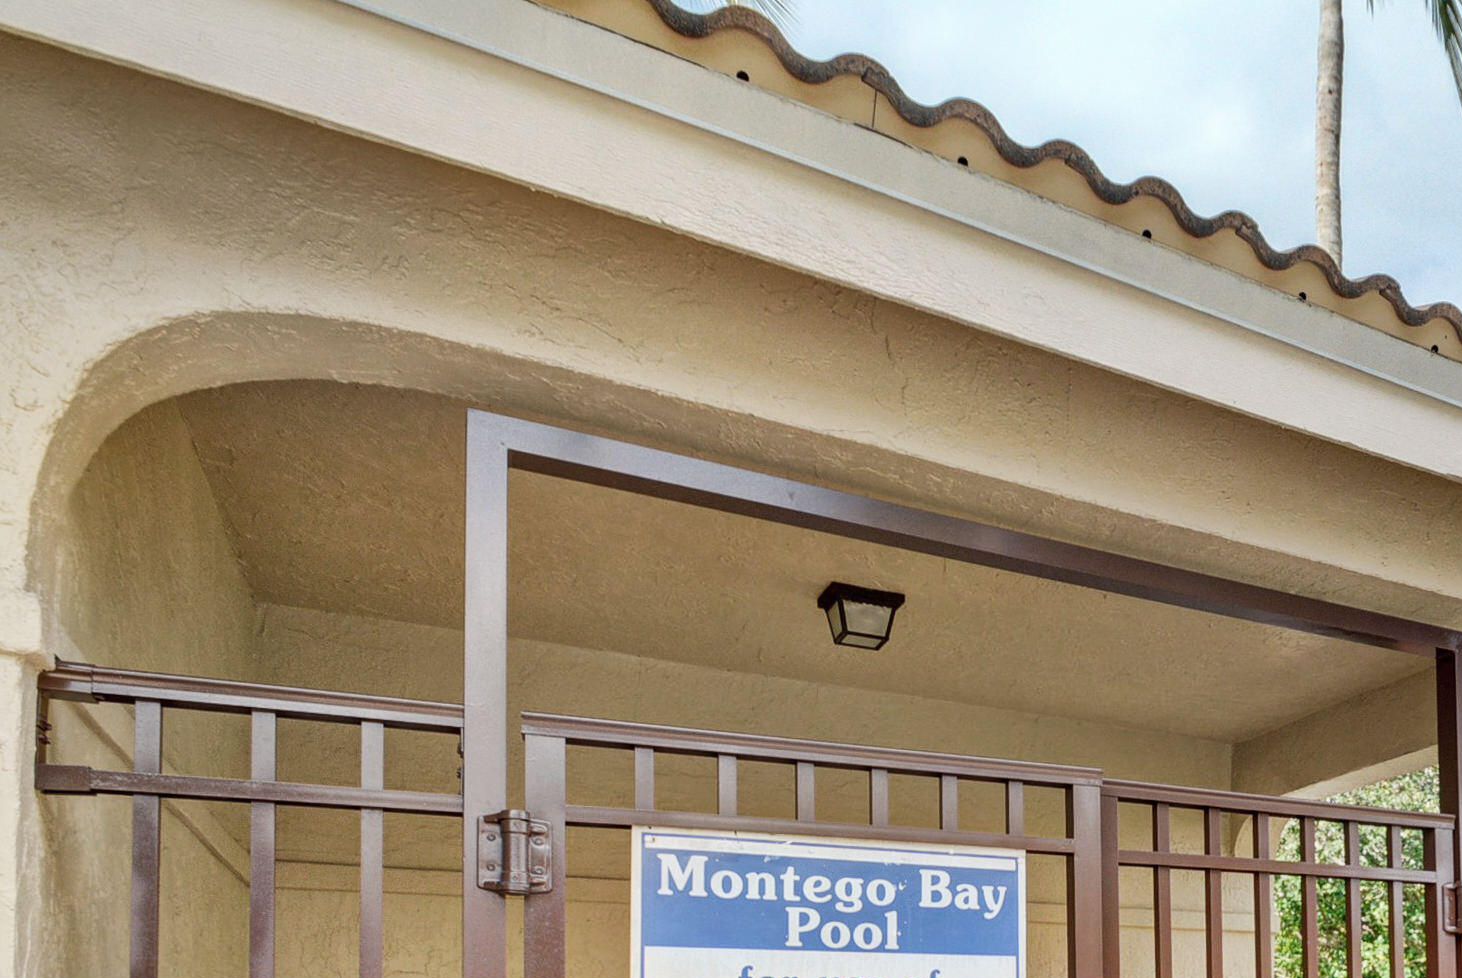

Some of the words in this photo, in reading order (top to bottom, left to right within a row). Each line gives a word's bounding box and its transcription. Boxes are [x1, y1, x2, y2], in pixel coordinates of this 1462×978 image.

[656, 853, 897, 913] Montego
[919, 869, 1008, 920] Bay
[785, 907, 900, 951] Pool
